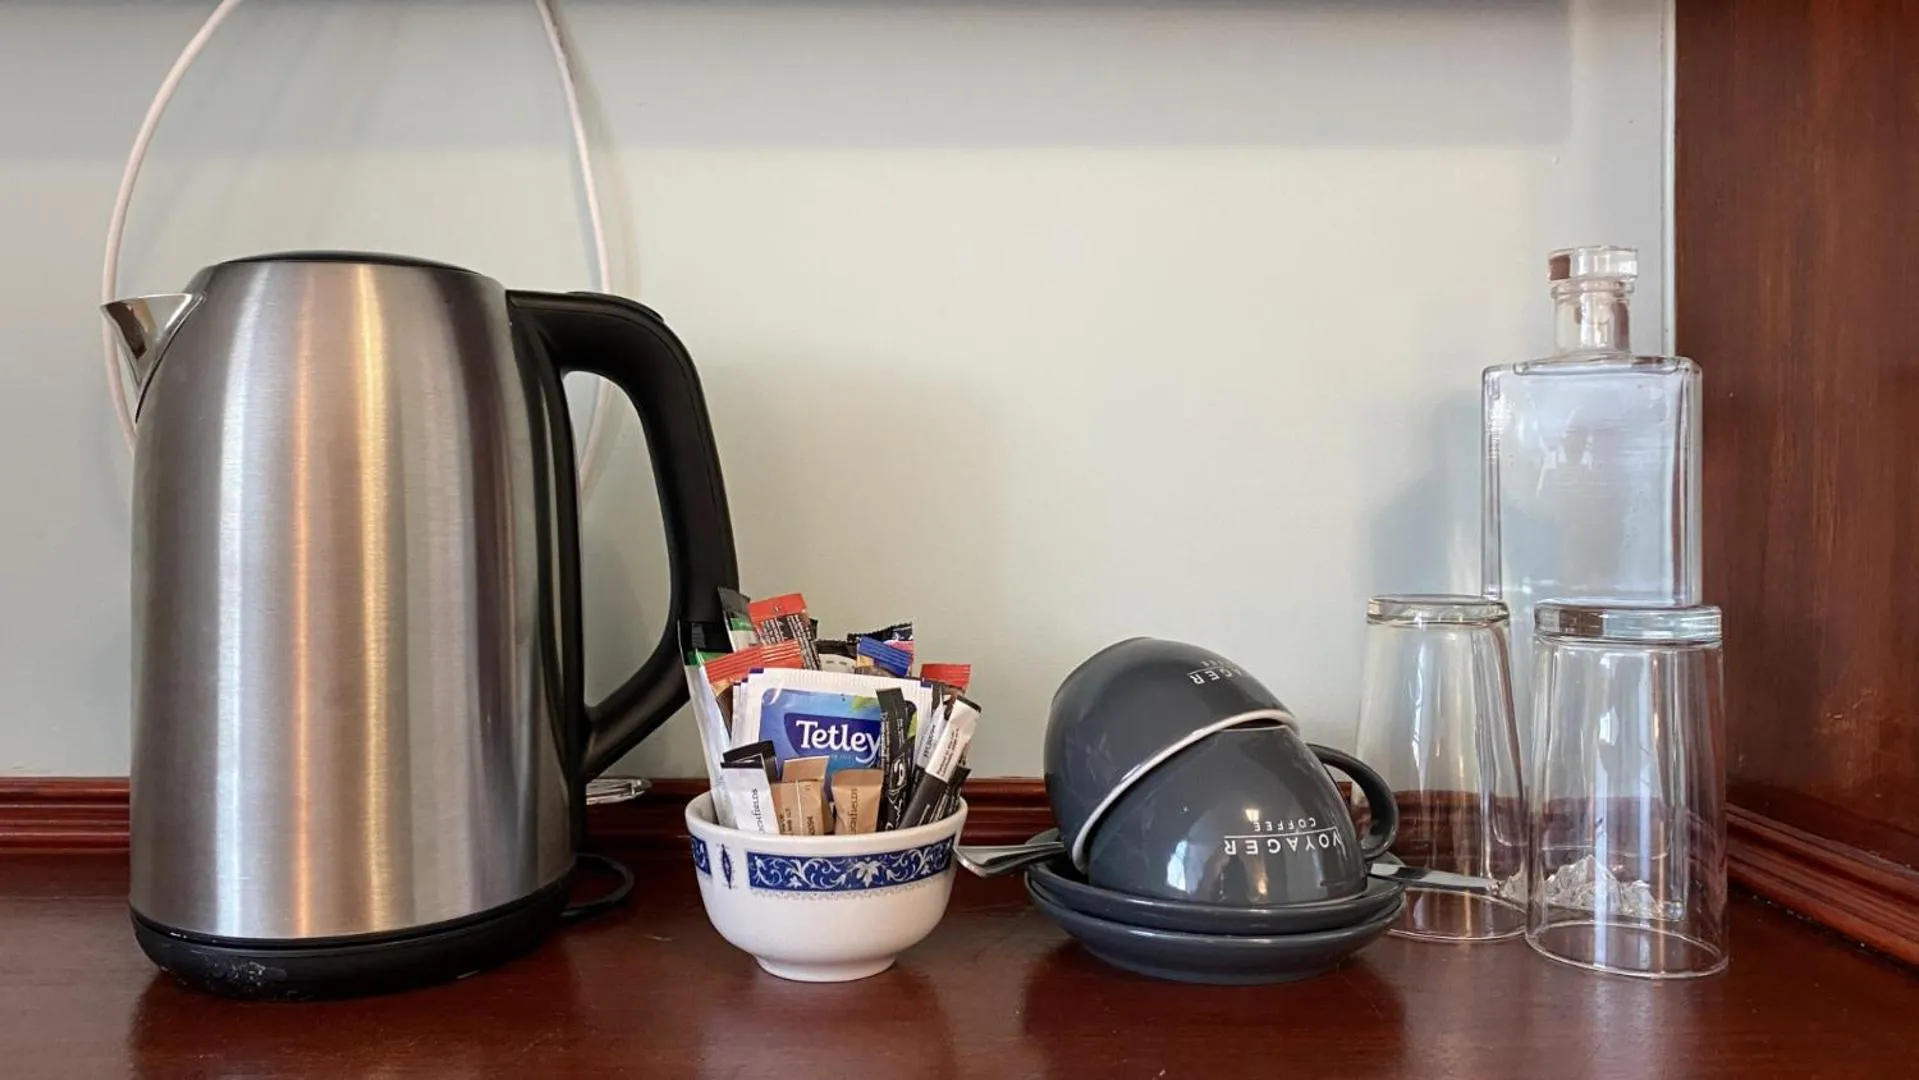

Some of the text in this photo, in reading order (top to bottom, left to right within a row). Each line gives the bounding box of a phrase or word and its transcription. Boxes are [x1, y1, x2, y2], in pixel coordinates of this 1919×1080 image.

[796, 720, 881, 763] Tetley
[1253, 817, 1316, 832] COFFEE
[1224, 831, 1345, 856] VOYAGER
